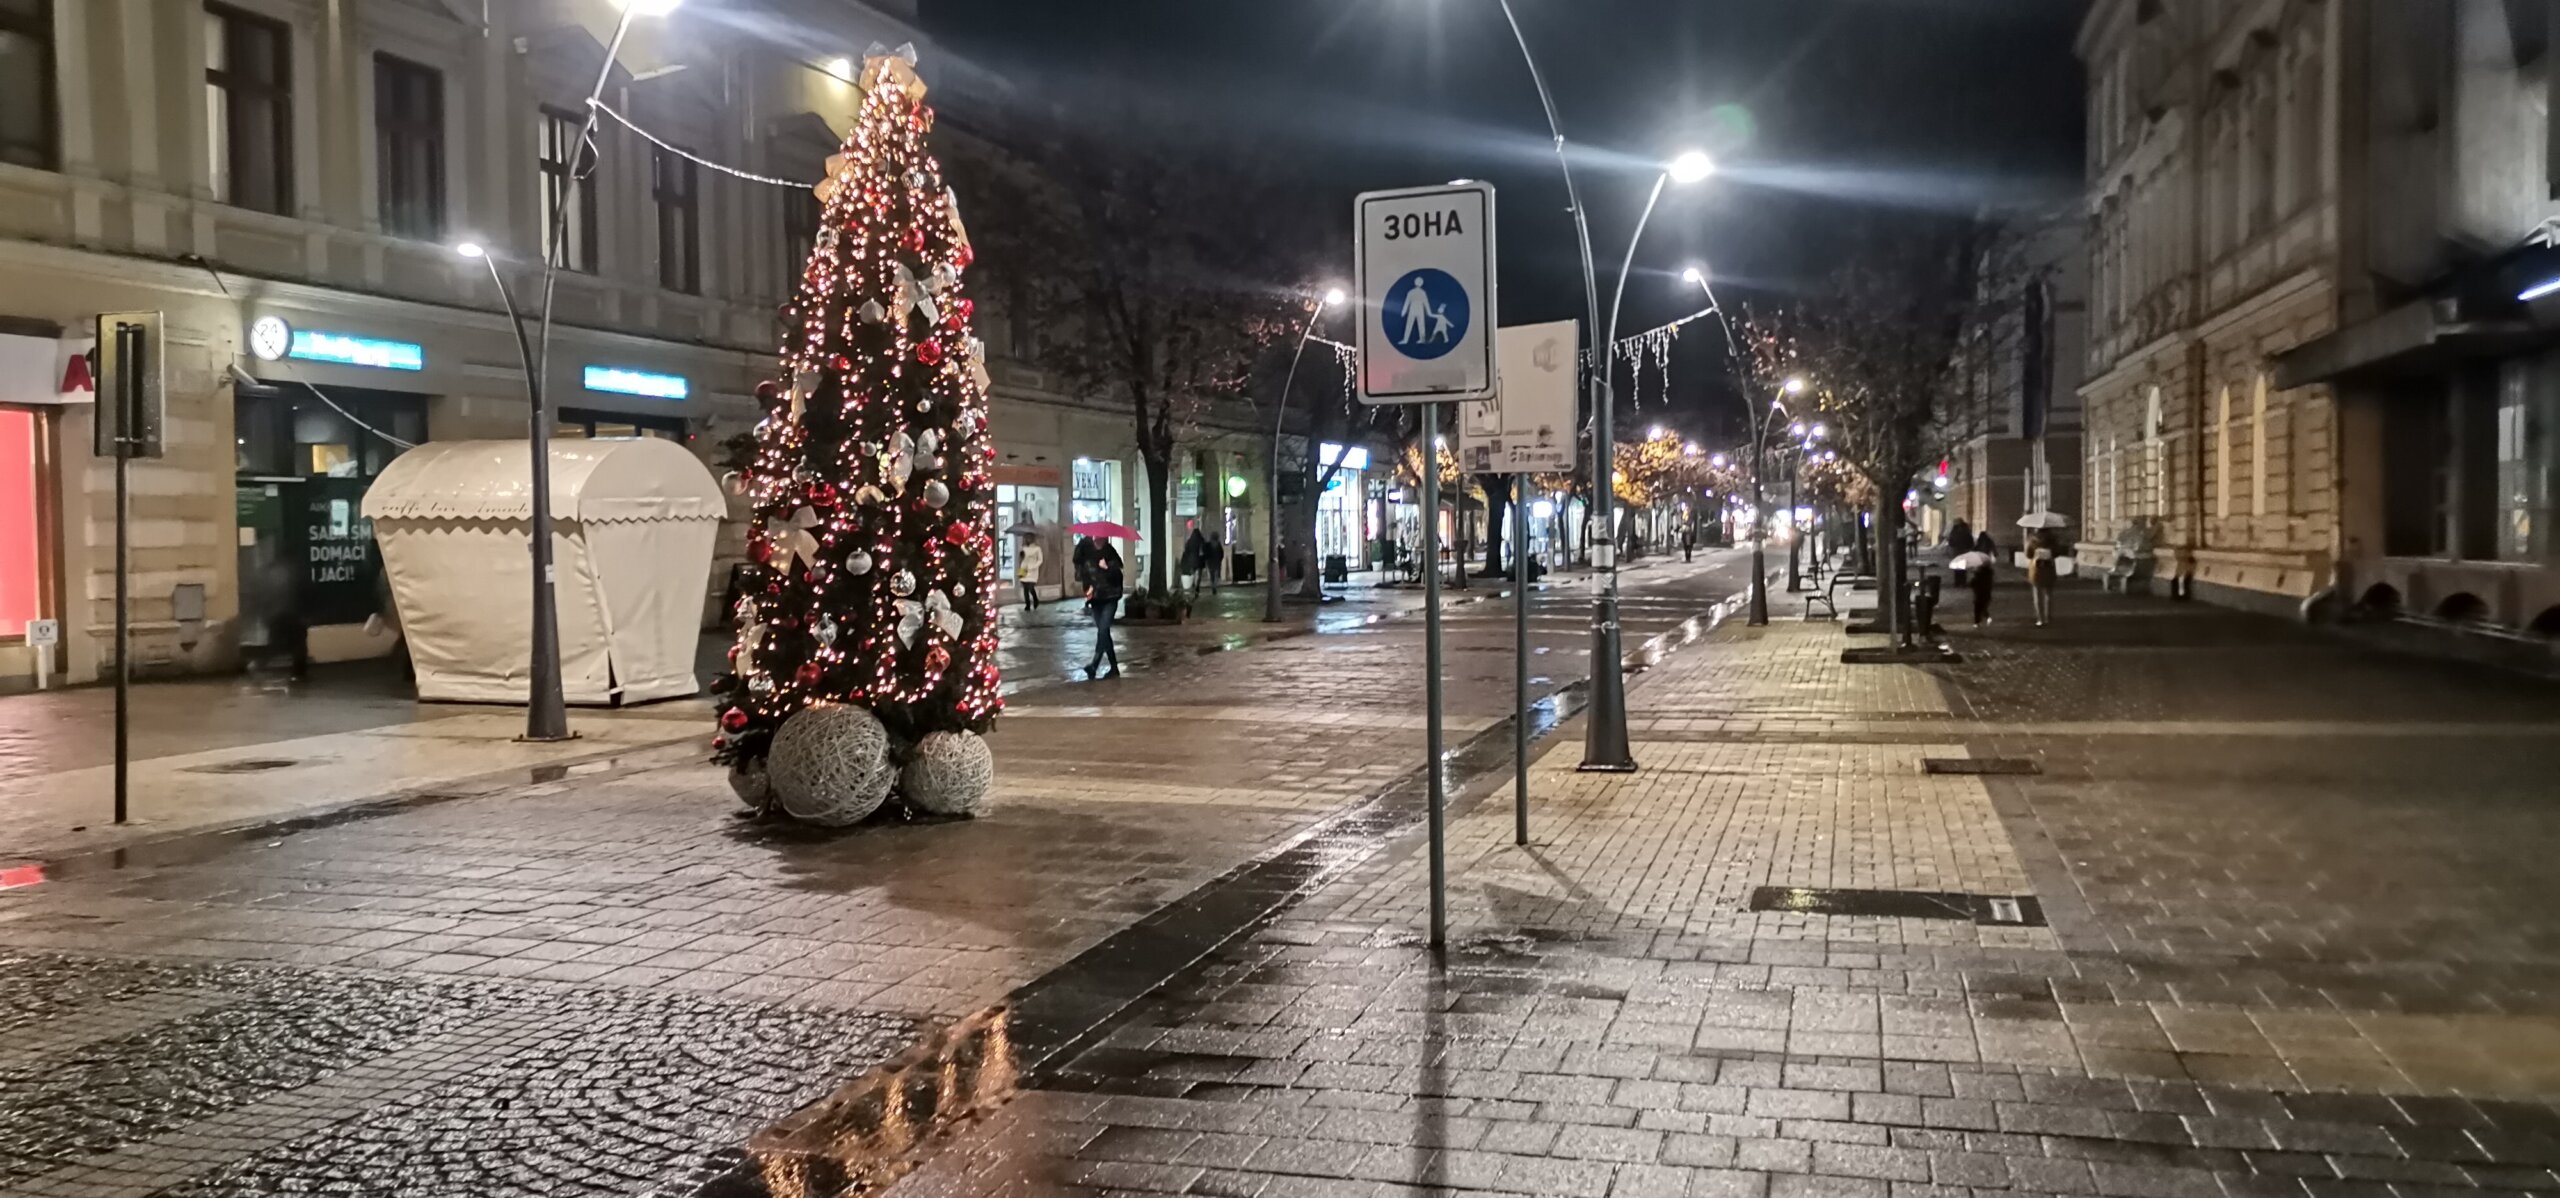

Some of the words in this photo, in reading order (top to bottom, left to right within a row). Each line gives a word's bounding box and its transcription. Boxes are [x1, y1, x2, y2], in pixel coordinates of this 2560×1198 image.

[1383, 209, 1463, 240] ЗОНА
[1075, 472, 1099, 489] VEKA
[308, 525, 348, 540] SA
[311, 567, 316, 582] I
